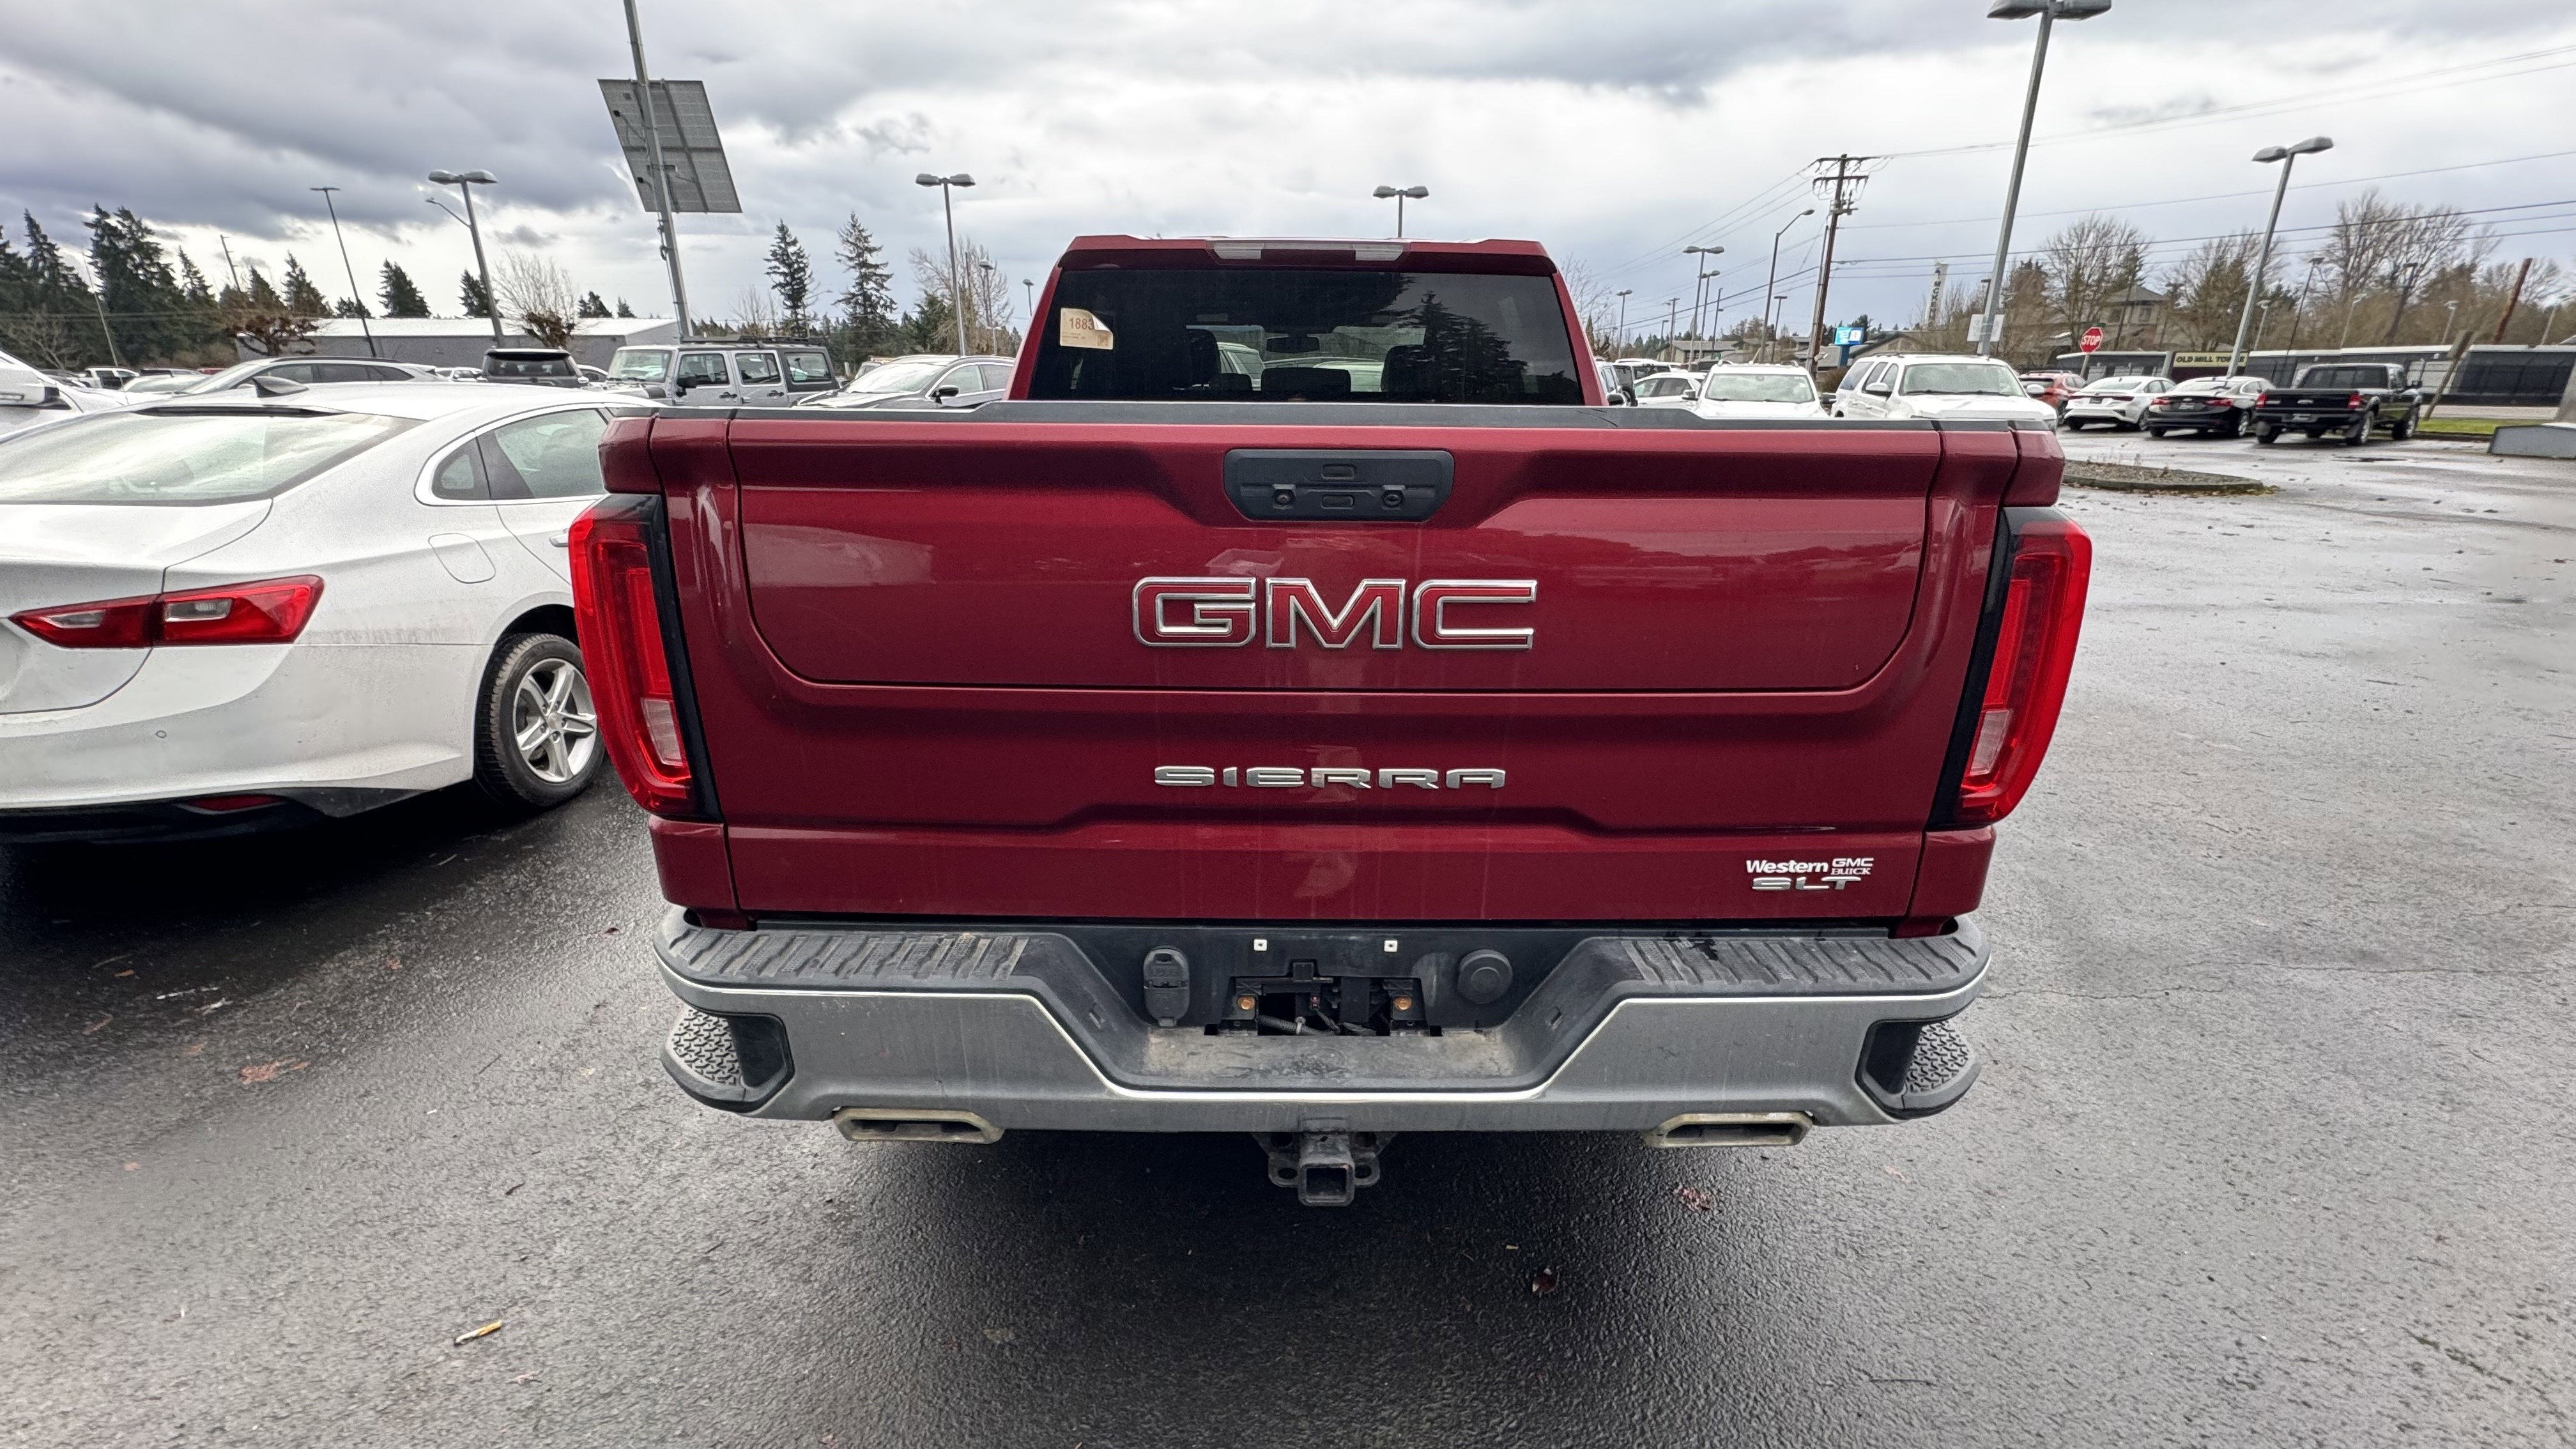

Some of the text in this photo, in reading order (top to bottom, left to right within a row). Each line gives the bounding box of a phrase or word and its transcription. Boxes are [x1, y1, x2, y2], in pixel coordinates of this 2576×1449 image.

[2082, 335, 2101, 346] STOP
[1132, 576, 1538, 650] GMC
[1154, 766, 1506, 790] SIERRA
[1745, 857, 1874, 874] Western GMC
[1751, 876, 1862, 891] SLT
